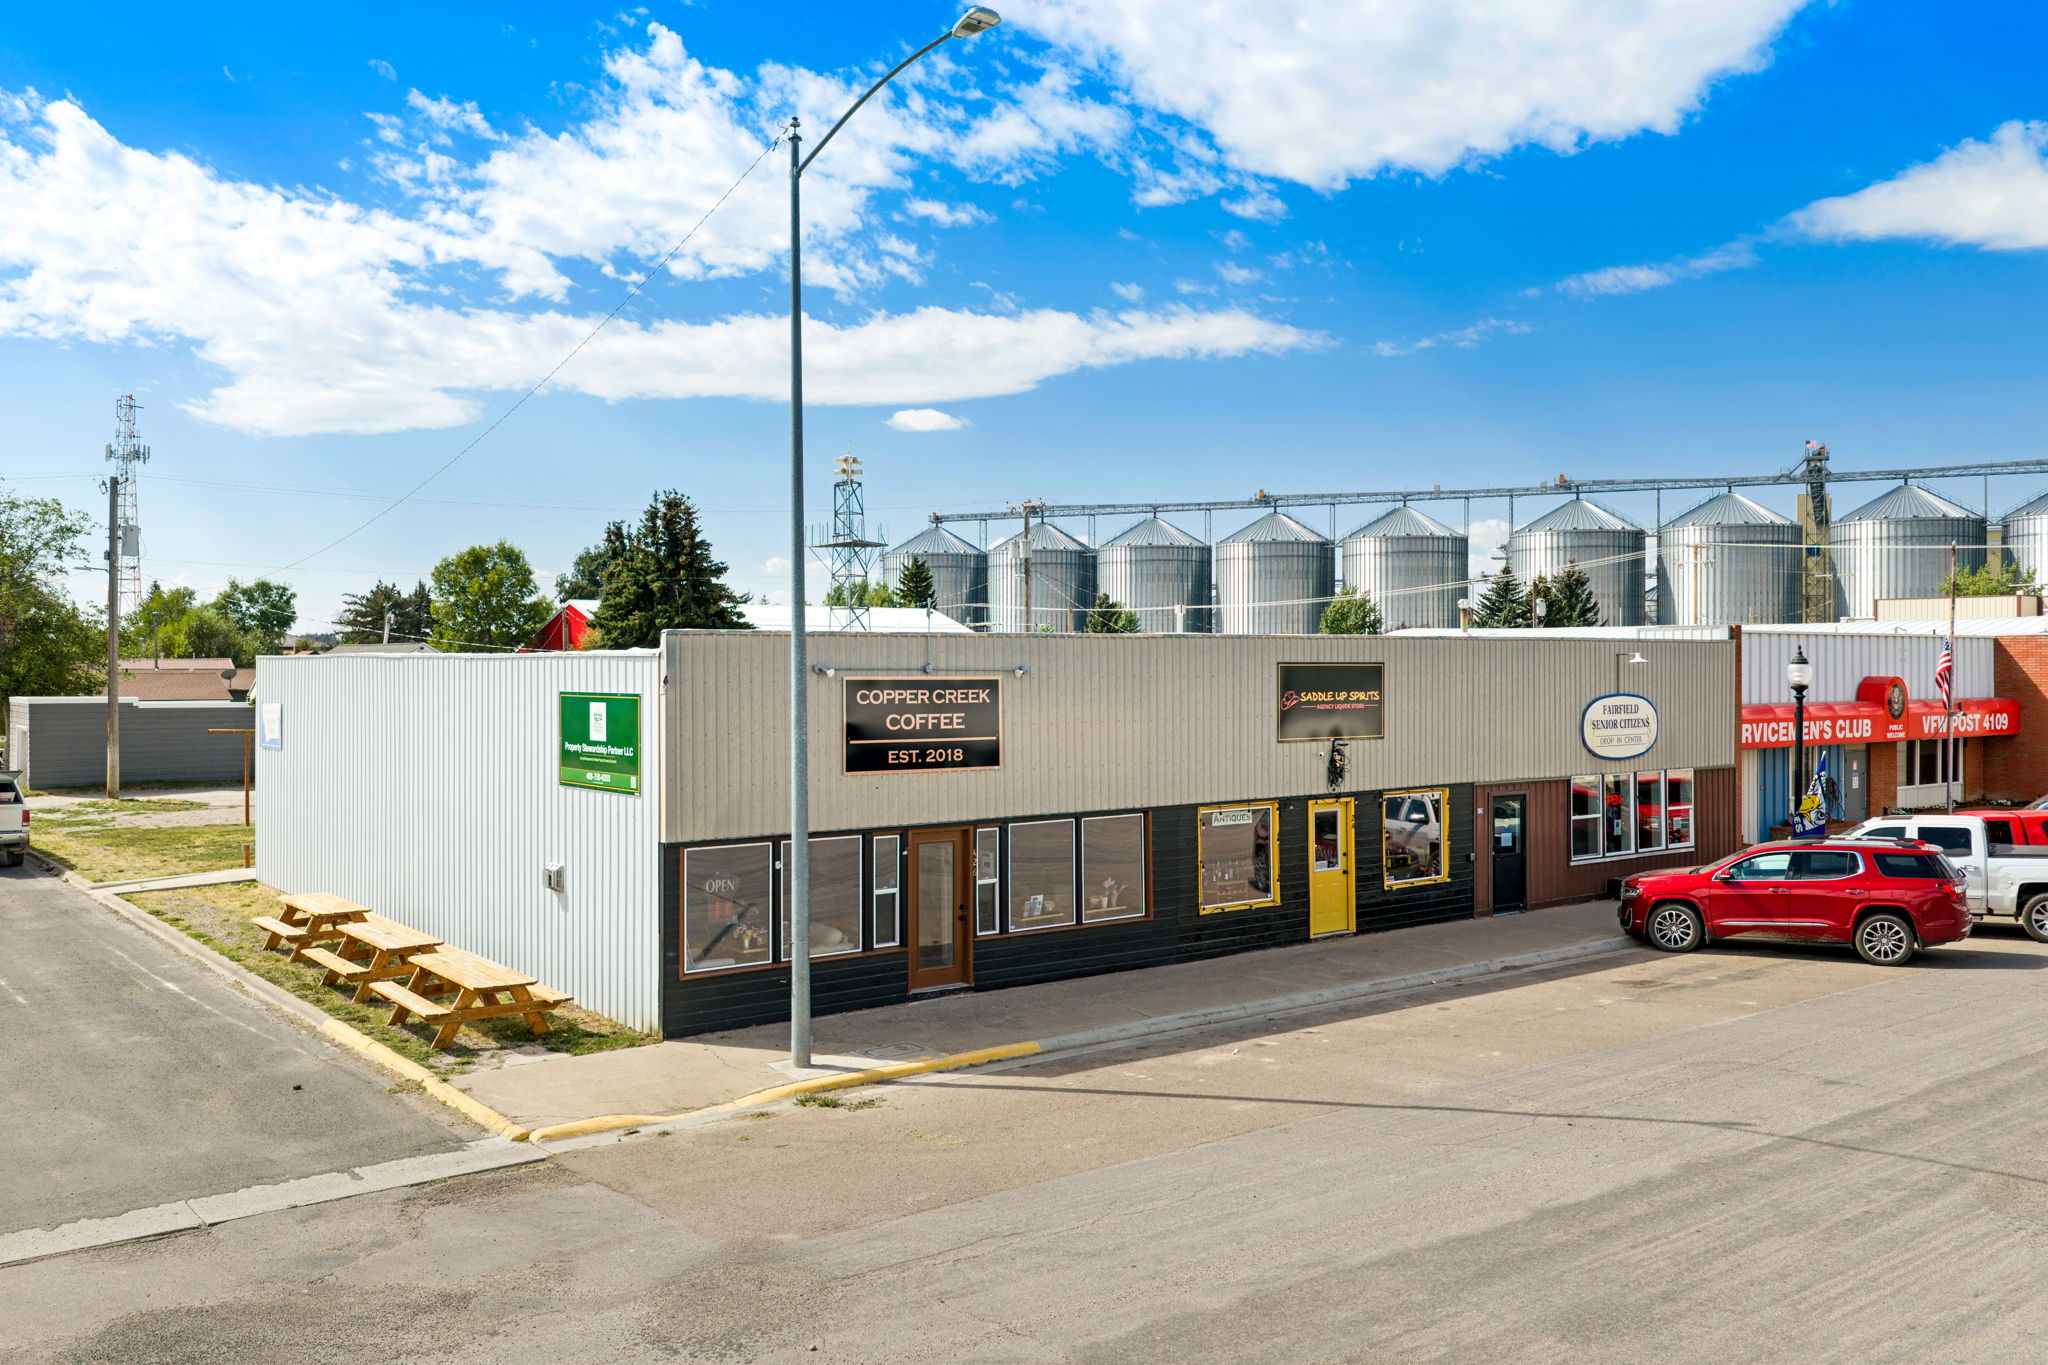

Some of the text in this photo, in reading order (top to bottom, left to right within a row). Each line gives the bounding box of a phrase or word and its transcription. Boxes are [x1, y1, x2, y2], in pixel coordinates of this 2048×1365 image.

[856, 689, 991, 705] COPPER CREEK
[1300, 690, 1380, 702] SADDLE UP SPIRITS
[1603, 704, 1639, 715] FAIRFIELD
[886, 713, 966, 730] COFFEE
[1592, 717, 1650, 730] SENIOR CITIZENS
[1836, 719, 1872, 738] CLUB
[1922, 713, 2008, 734] VFW POST 4109
[1600, 737, 1614, 745] DROP
[1624, 736, 1642, 744] CENTER
[565, 742, 581, 753] Property
[582, 743, 607, 755] Stewardship
[624, 747, 633, 756] LLC
[888, 748, 963, 764] EST. 2018
[705, 879, 735, 893] OPEN
